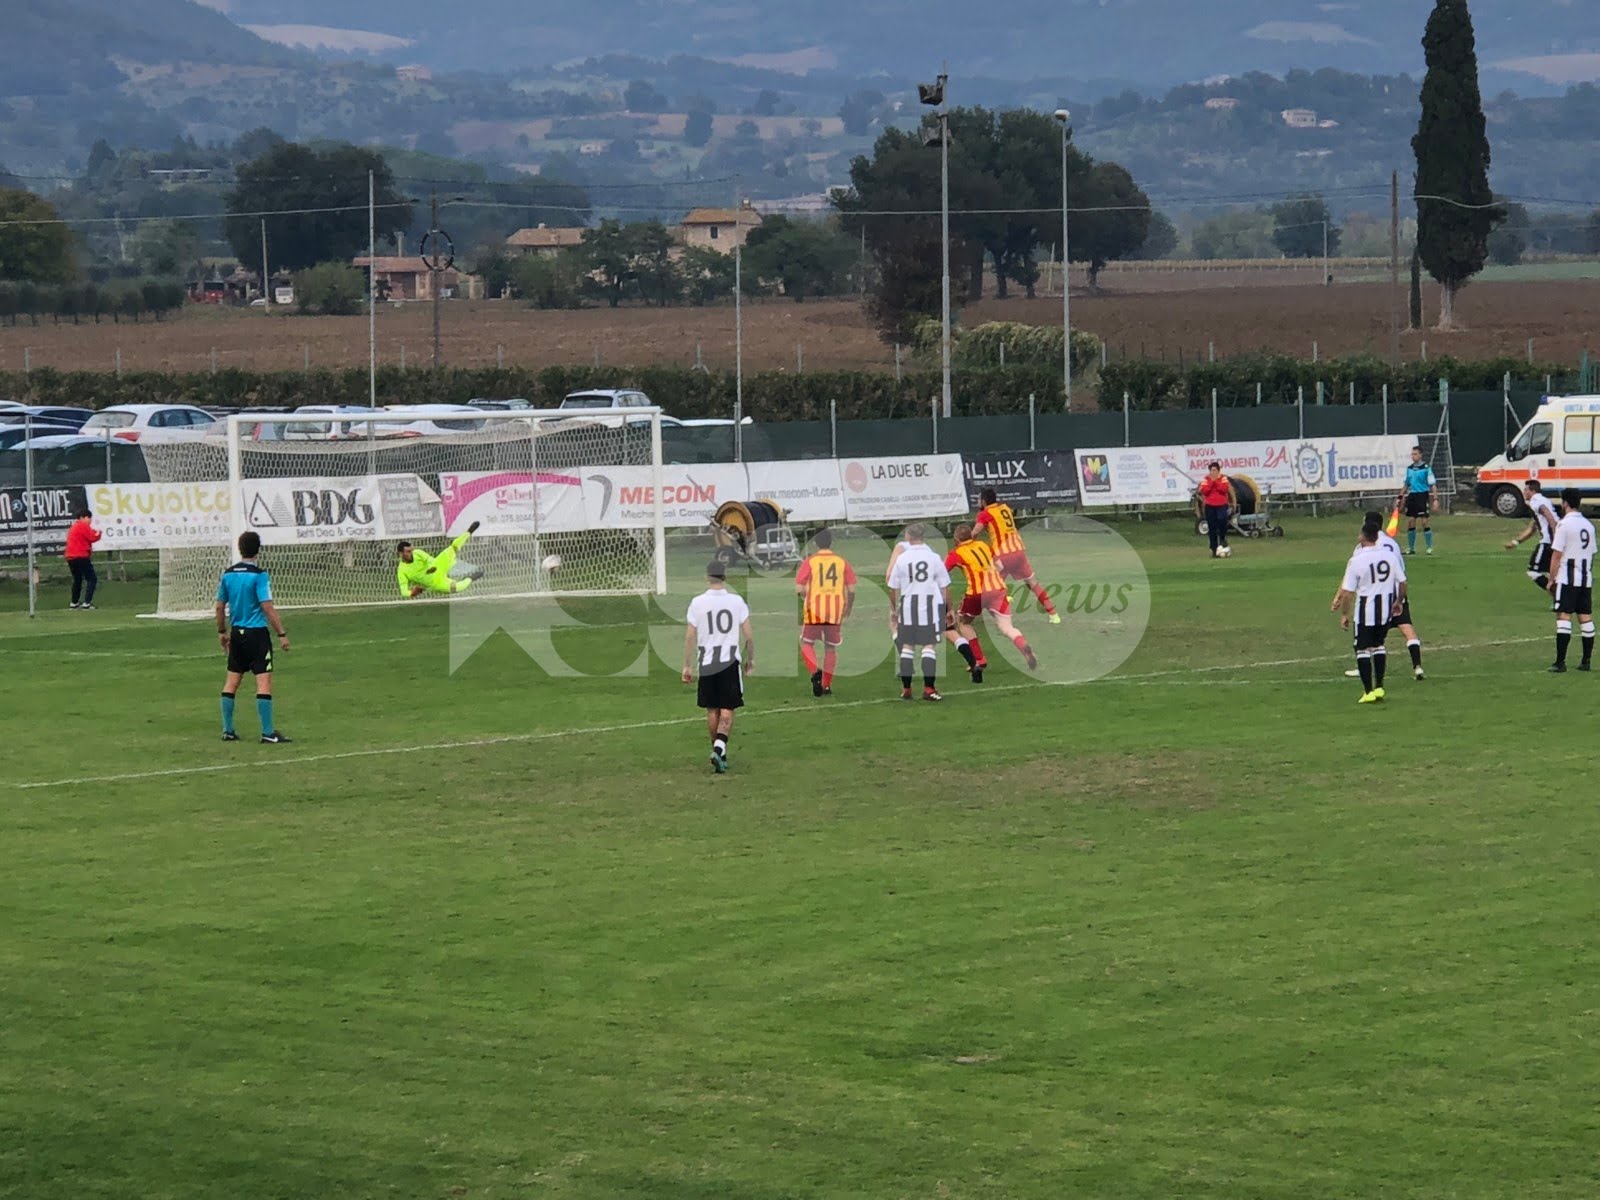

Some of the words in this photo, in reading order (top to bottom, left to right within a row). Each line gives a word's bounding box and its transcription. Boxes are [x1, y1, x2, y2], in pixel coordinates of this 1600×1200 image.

[1187, 447, 1217, 458] NUOVA
[871, 465, 887, 480] LA
[888, 463, 912, 479] DUE
[914, 462, 930, 477] BC
[1325, 442, 1394, 488] tacconi
[21, 489, 73, 518] SERVICE
[619, 485, 716, 505] MECOM
[291, 488, 375, 526] BDG
[1000, 508, 1013, 528] 9
[1580, 529, 1590, 549] 9
[971, 546, 991, 568] 11
[819, 562, 838, 587] 14
[908, 560, 929, 583] 18
[1369, 560, 1391, 584] 19
[706, 608, 733, 634] 10
